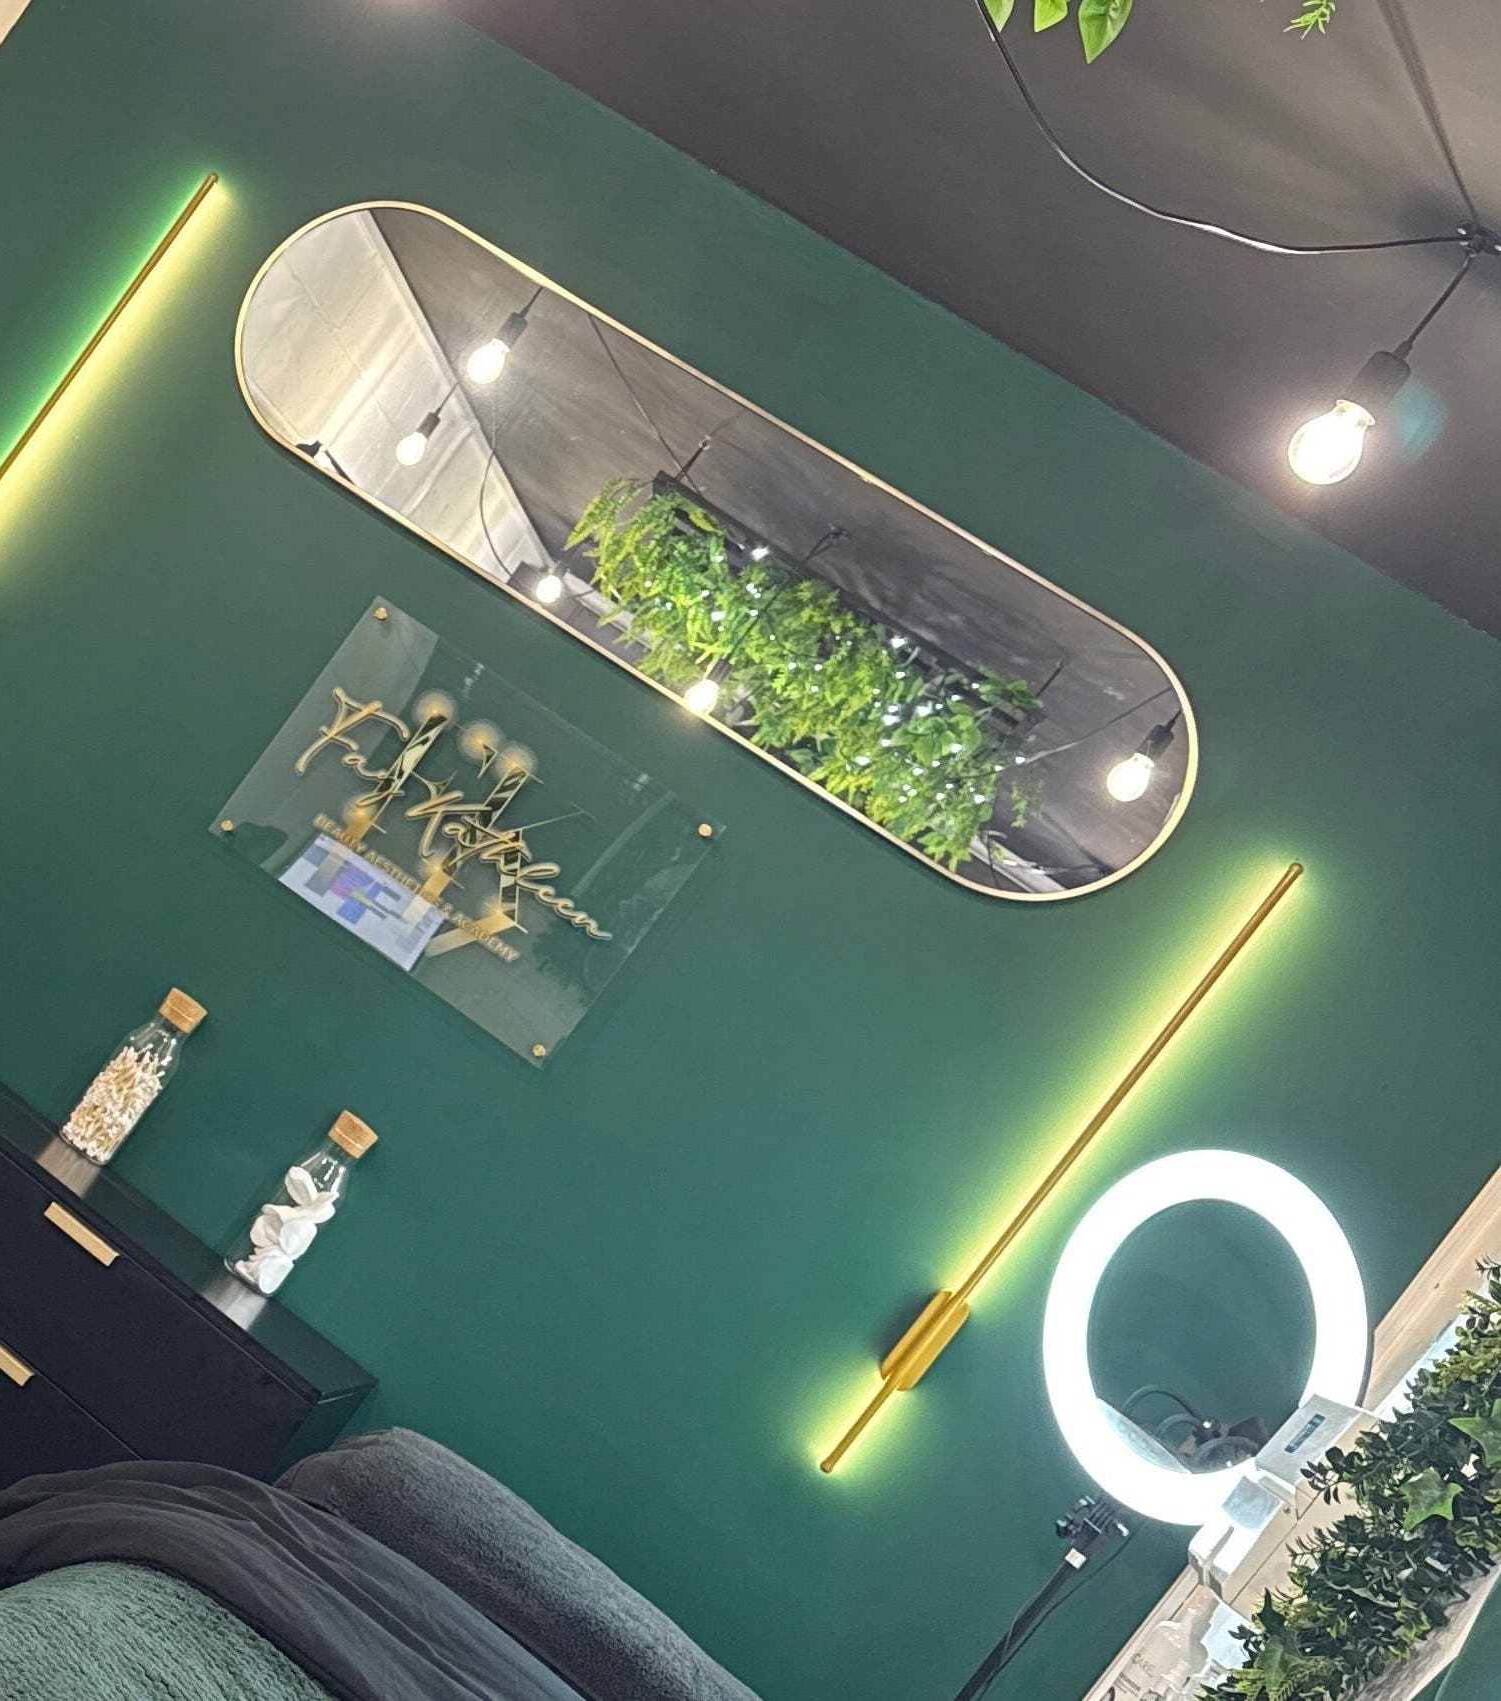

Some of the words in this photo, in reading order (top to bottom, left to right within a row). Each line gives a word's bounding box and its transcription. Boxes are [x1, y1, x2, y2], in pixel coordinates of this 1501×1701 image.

[296, 686, 410, 808] Fay
[315, 814, 366, 852] BEAUTY
[451, 911, 519, 961] ACADEMY
